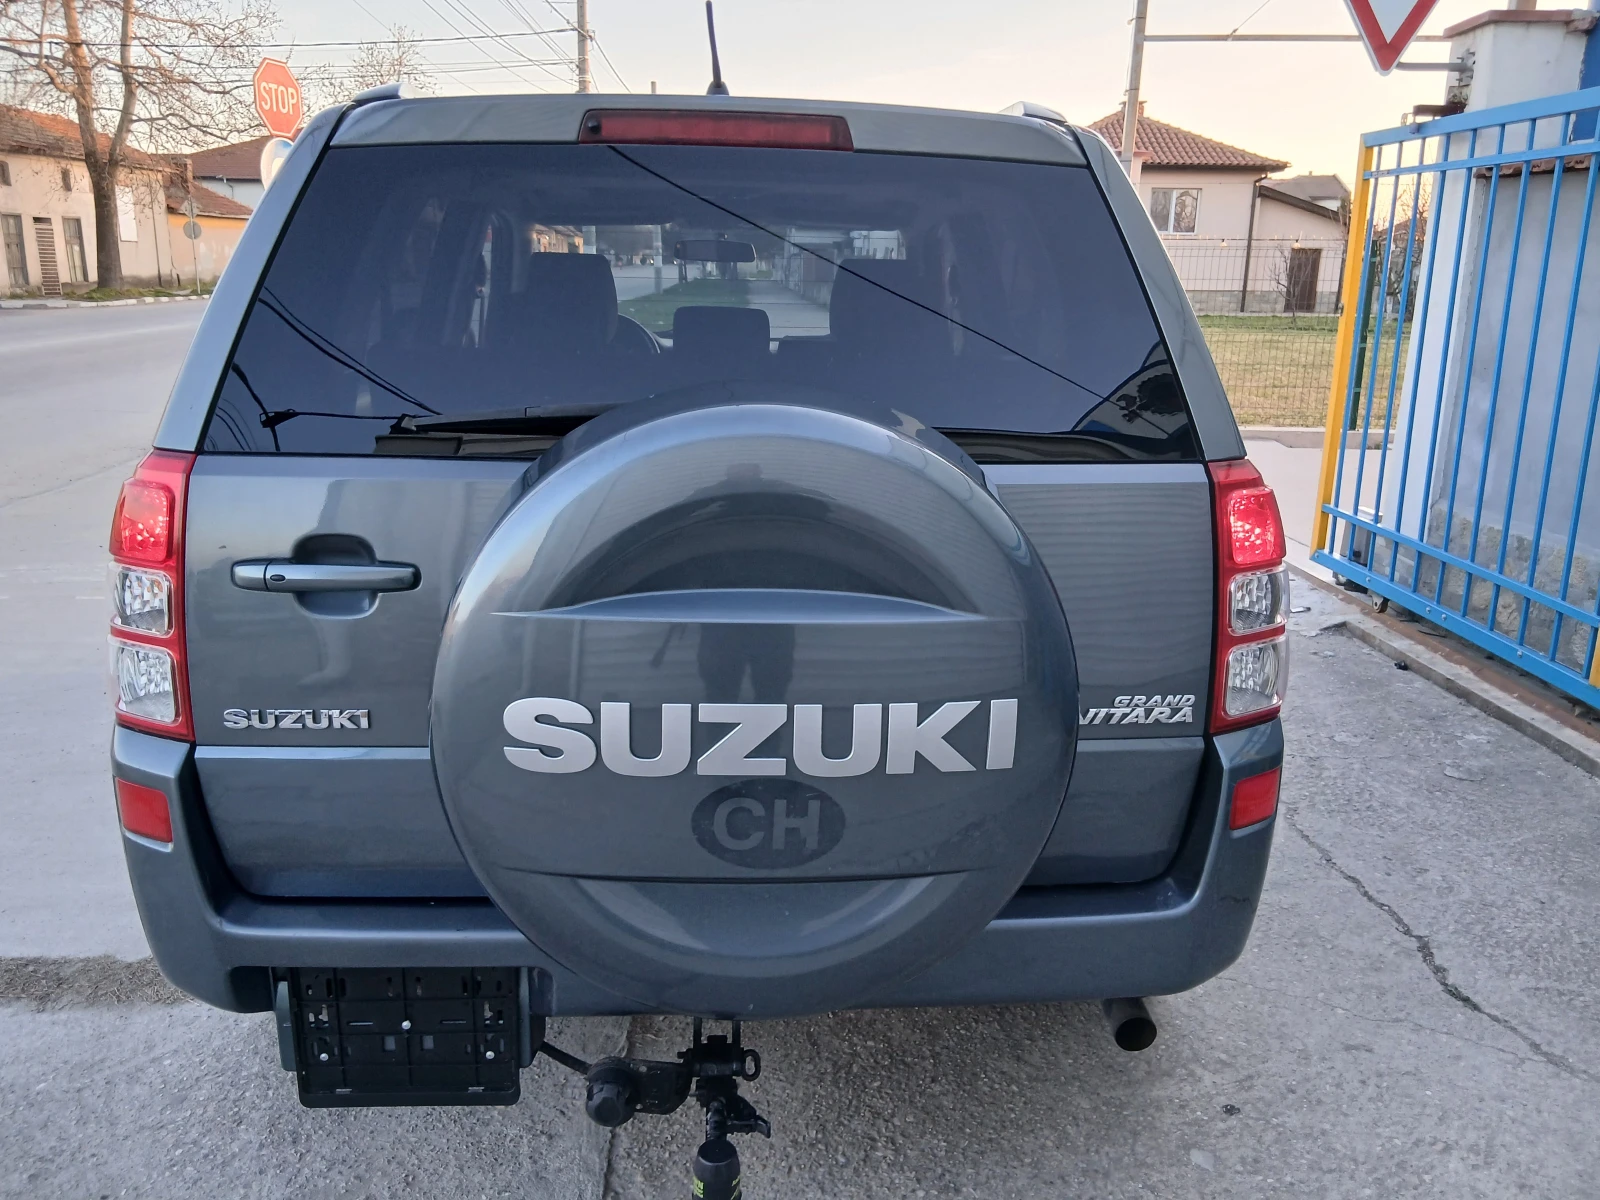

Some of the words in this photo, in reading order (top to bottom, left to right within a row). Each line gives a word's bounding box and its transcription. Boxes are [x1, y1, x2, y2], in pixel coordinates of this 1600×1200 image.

[260, 81, 297, 115] STOP
[1113, 695, 1196, 708] GRAND
[223, 708, 369, 730] SUZUKI
[503, 697, 1019, 777] SUZUKI
[713, 797, 821, 850] CH
